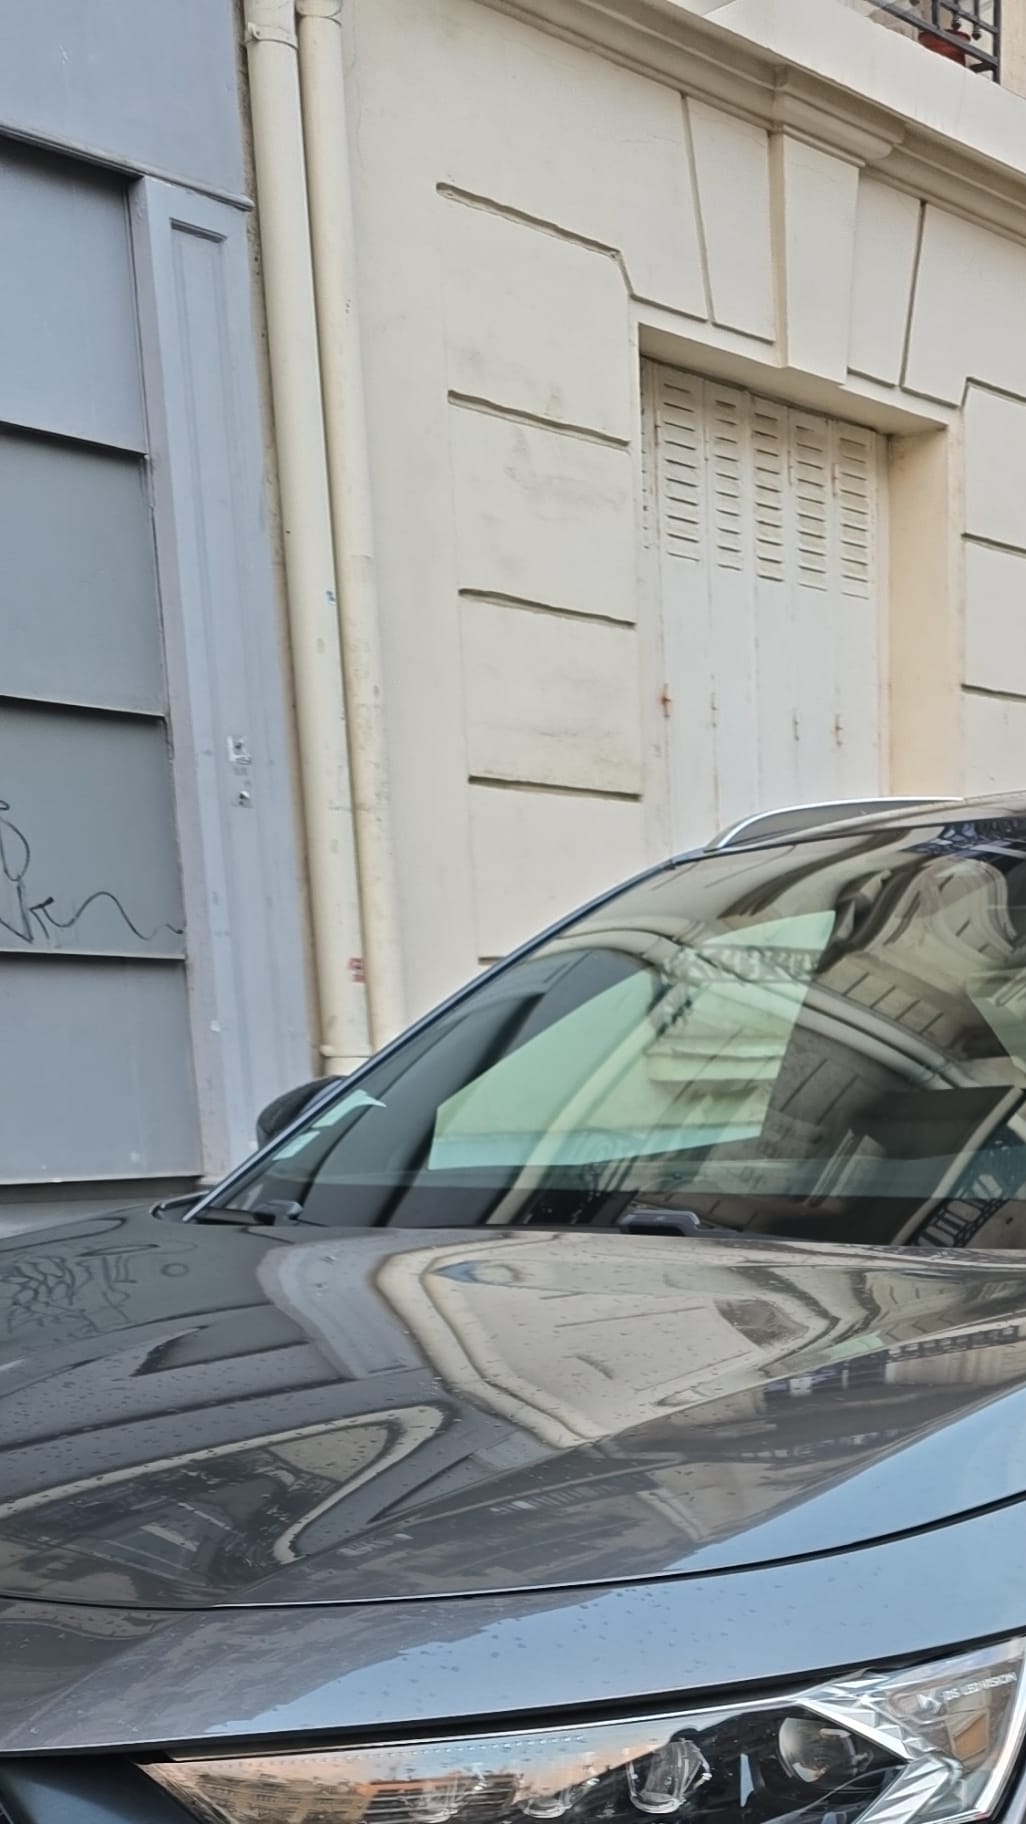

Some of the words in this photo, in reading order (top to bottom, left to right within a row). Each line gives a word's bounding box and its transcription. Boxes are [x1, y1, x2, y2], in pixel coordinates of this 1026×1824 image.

[942, 1687, 960, 1701] DS
[963, 1681, 981, 1696] LED
[981, 1672, 1017, 1690] VISION
